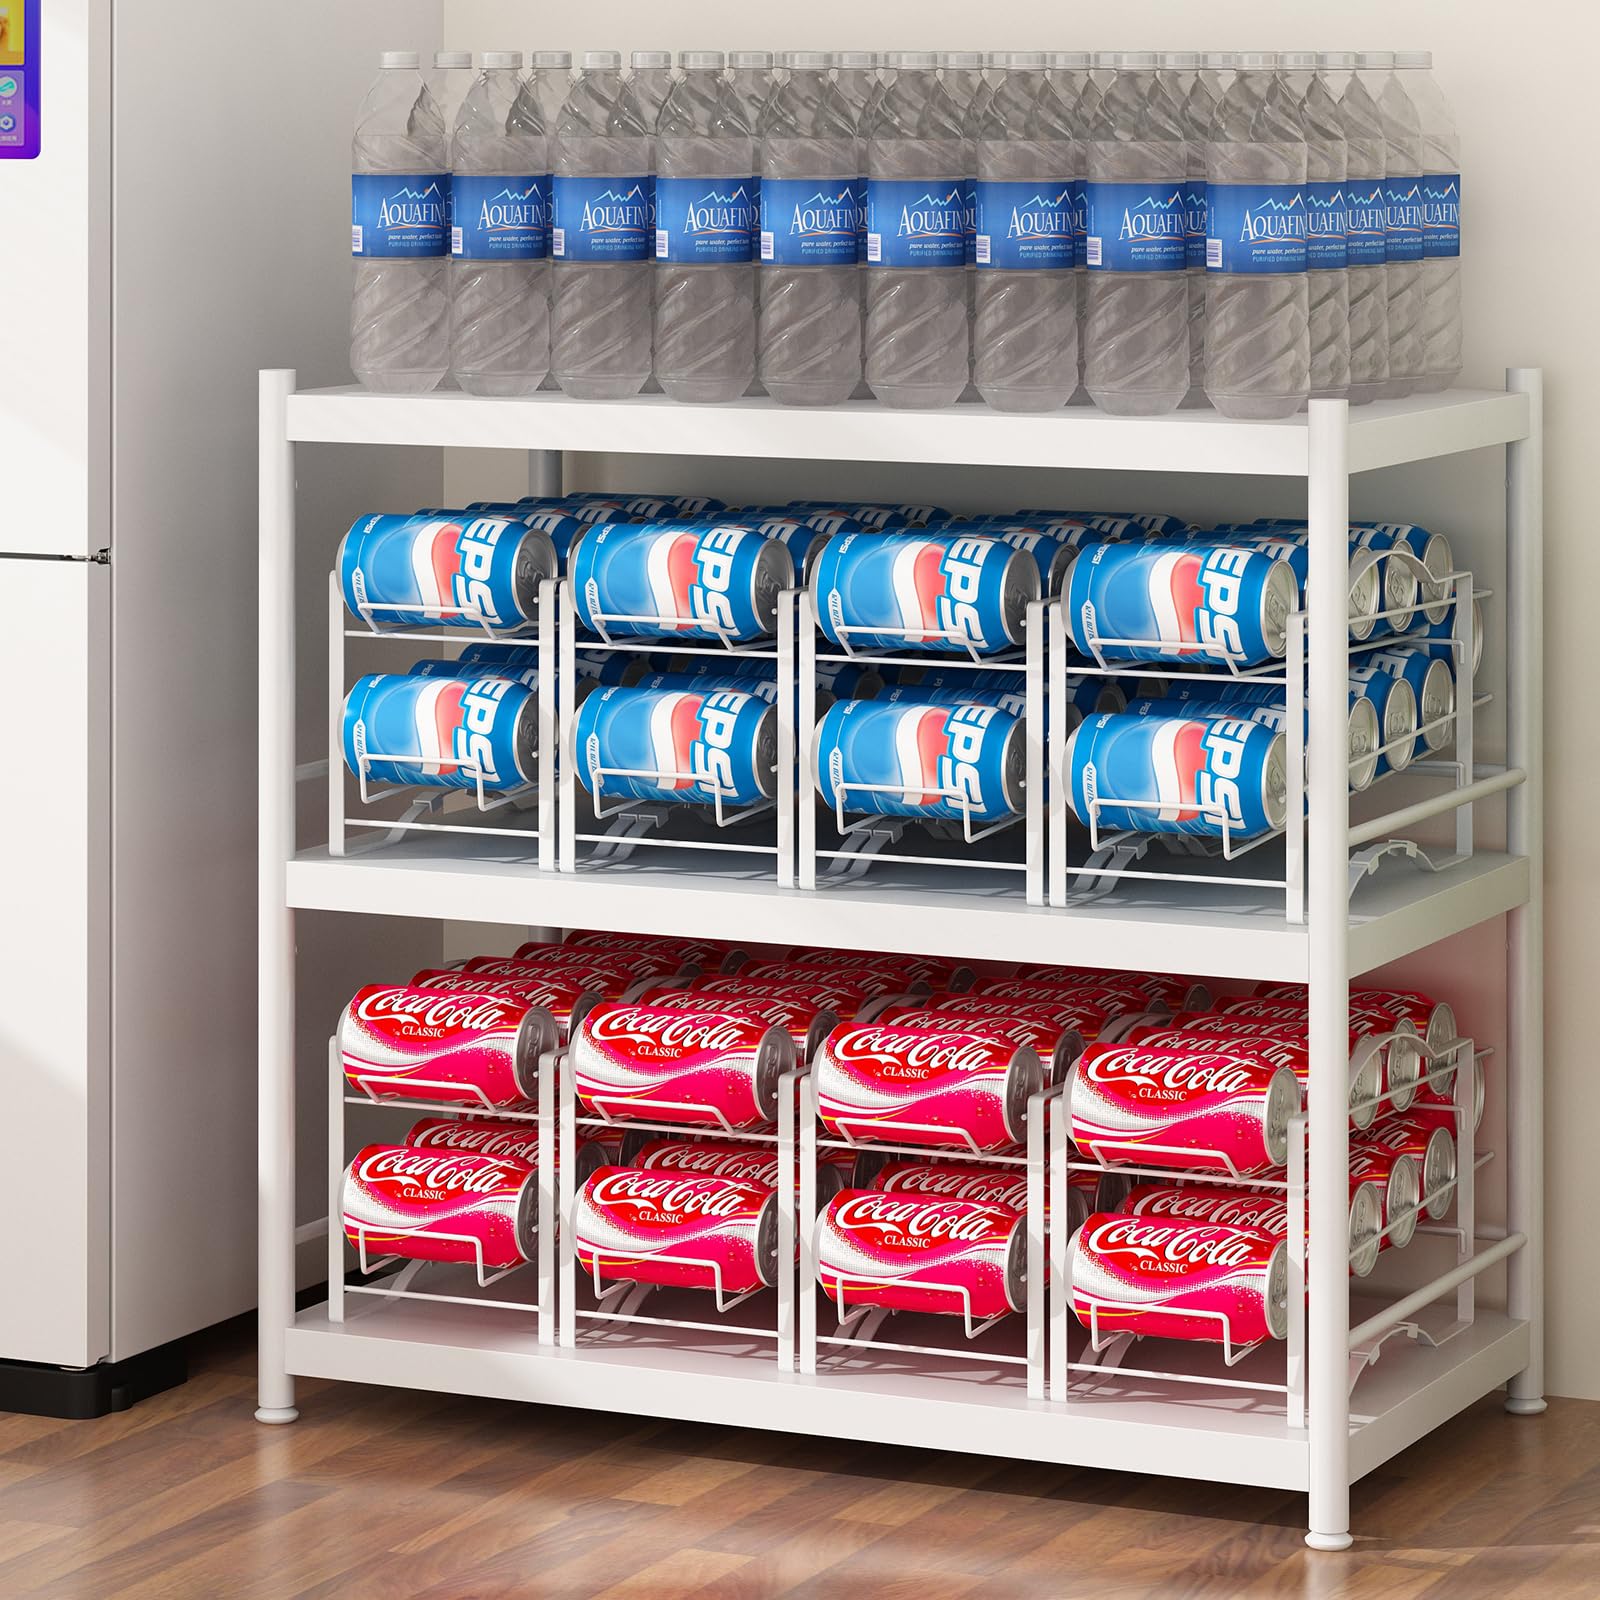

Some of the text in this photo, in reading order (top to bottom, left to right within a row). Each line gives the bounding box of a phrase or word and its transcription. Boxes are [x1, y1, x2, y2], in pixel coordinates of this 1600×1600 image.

[376, 198, 446, 228] AQUAFIN
[477, 200, 546, 230] AQUAFIN
[579, 200, 648, 232] AQUAFIN
[683, 202, 752, 234] AQUAFIN
[789, 203, 857, 235] AQUAFIN
[897, 205, 964, 236] AQUAFIN
[1006, 206, 1074, 238] AQUAFIN
[1118, 208, 1186, 240] AQUAFIN
[1240, 210, 1306, 242] AQUAFIN
[357, 988, 523, 1030] Coca-Cola
[401, 1025, 445, 1038] CLASSIC
[591, 1008, 762, 1050] Coca-Cola
[637, 1045, 682, 1058] CLASSIC
[834, 1027, 1011, 1071] Coca-Cola
[883, 1066, 930, 1080] CLASSIC
[1087, 1048, 1271, 1093] Coca-Cola
[1138, 1087, 1187, 1101] CLASSIC
[359, 1149, 525, 1193] Coca-Cola
[403, 1187, 447, 1200] CLASSIC
[592, 1171, 764, 1216] Coca-Cola
[639, 1210, 684, 1224] CLASSIC
[835, 1194, 1012, 1241] Coca-Cola
[884, 1234, 931, 1249] CLASSIC
[1088, 1218, 1273, 1266] Coca-Cola
[1140, 1260, 1188, 1274] CLASSIC
